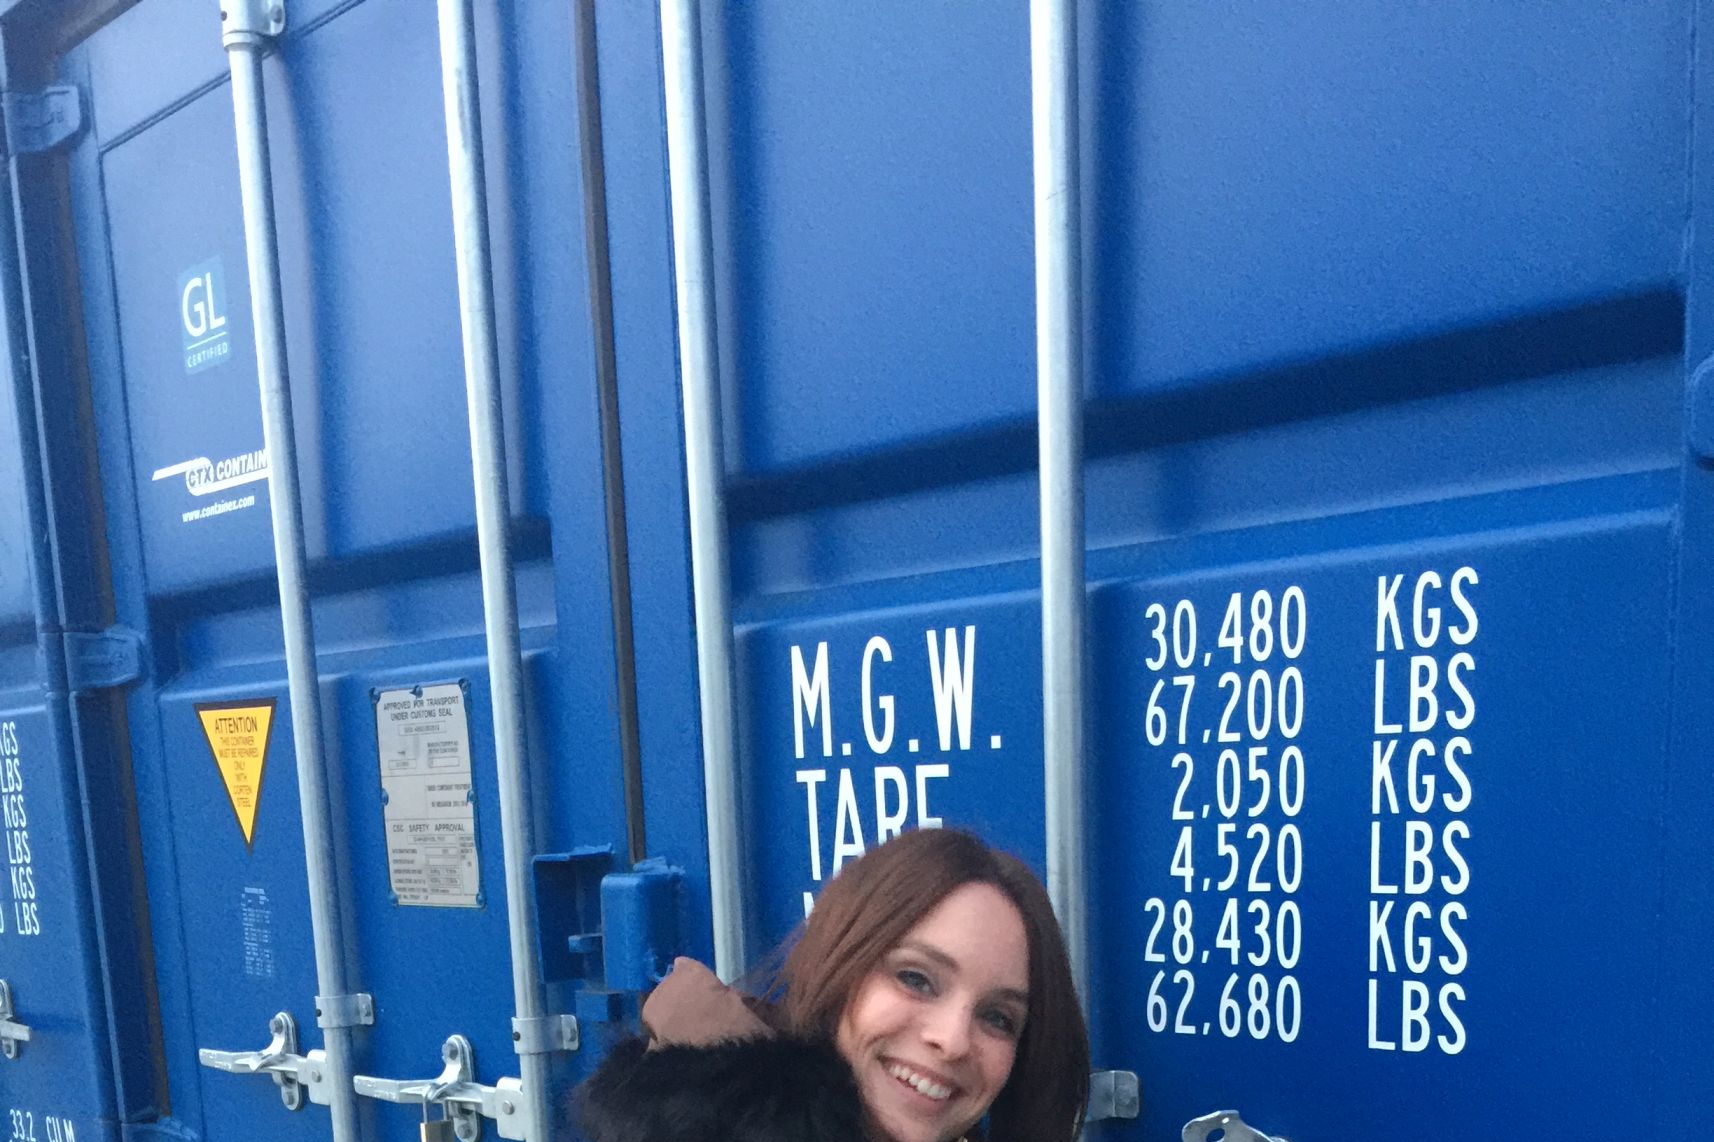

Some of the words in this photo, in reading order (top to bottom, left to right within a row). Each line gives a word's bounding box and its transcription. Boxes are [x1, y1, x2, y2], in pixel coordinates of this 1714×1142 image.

[182, 272, 226, 337] GL
[187, 342, 228, 368] CERTIFIED
[1145, 585, 1307, 671] 30,480
[1376, 566, 1479, 652] KGS
[790, 625, 1002, 759] M.G.W.
[1145, 666, 1304, 746] 67,200
[1374, 652, 1476, 734] LBS
[215, 716, 258, 734] ATTENTION
[0, 758, 23, 793] LBS
[1171, 745, 1305, 820] 2,050
[1372, 736, 1472, 814] KGS
[2, 794, 27, 828] KGS
[6, 830, 31, 864] LBS
[1170, 823, 1303, 893] 4,520
[1370, 820, 1470, 894] LBS
[10, 866, 36, 899] KGS
[15, 902, 40, 936] LBS
[1144, 897, 1302, 969] 28,430
[1369, 900, 1468, 975] KGS
[1146, 969, 1302, 1043] 62,680
[1368, 978, 1466, 1055] LBS
